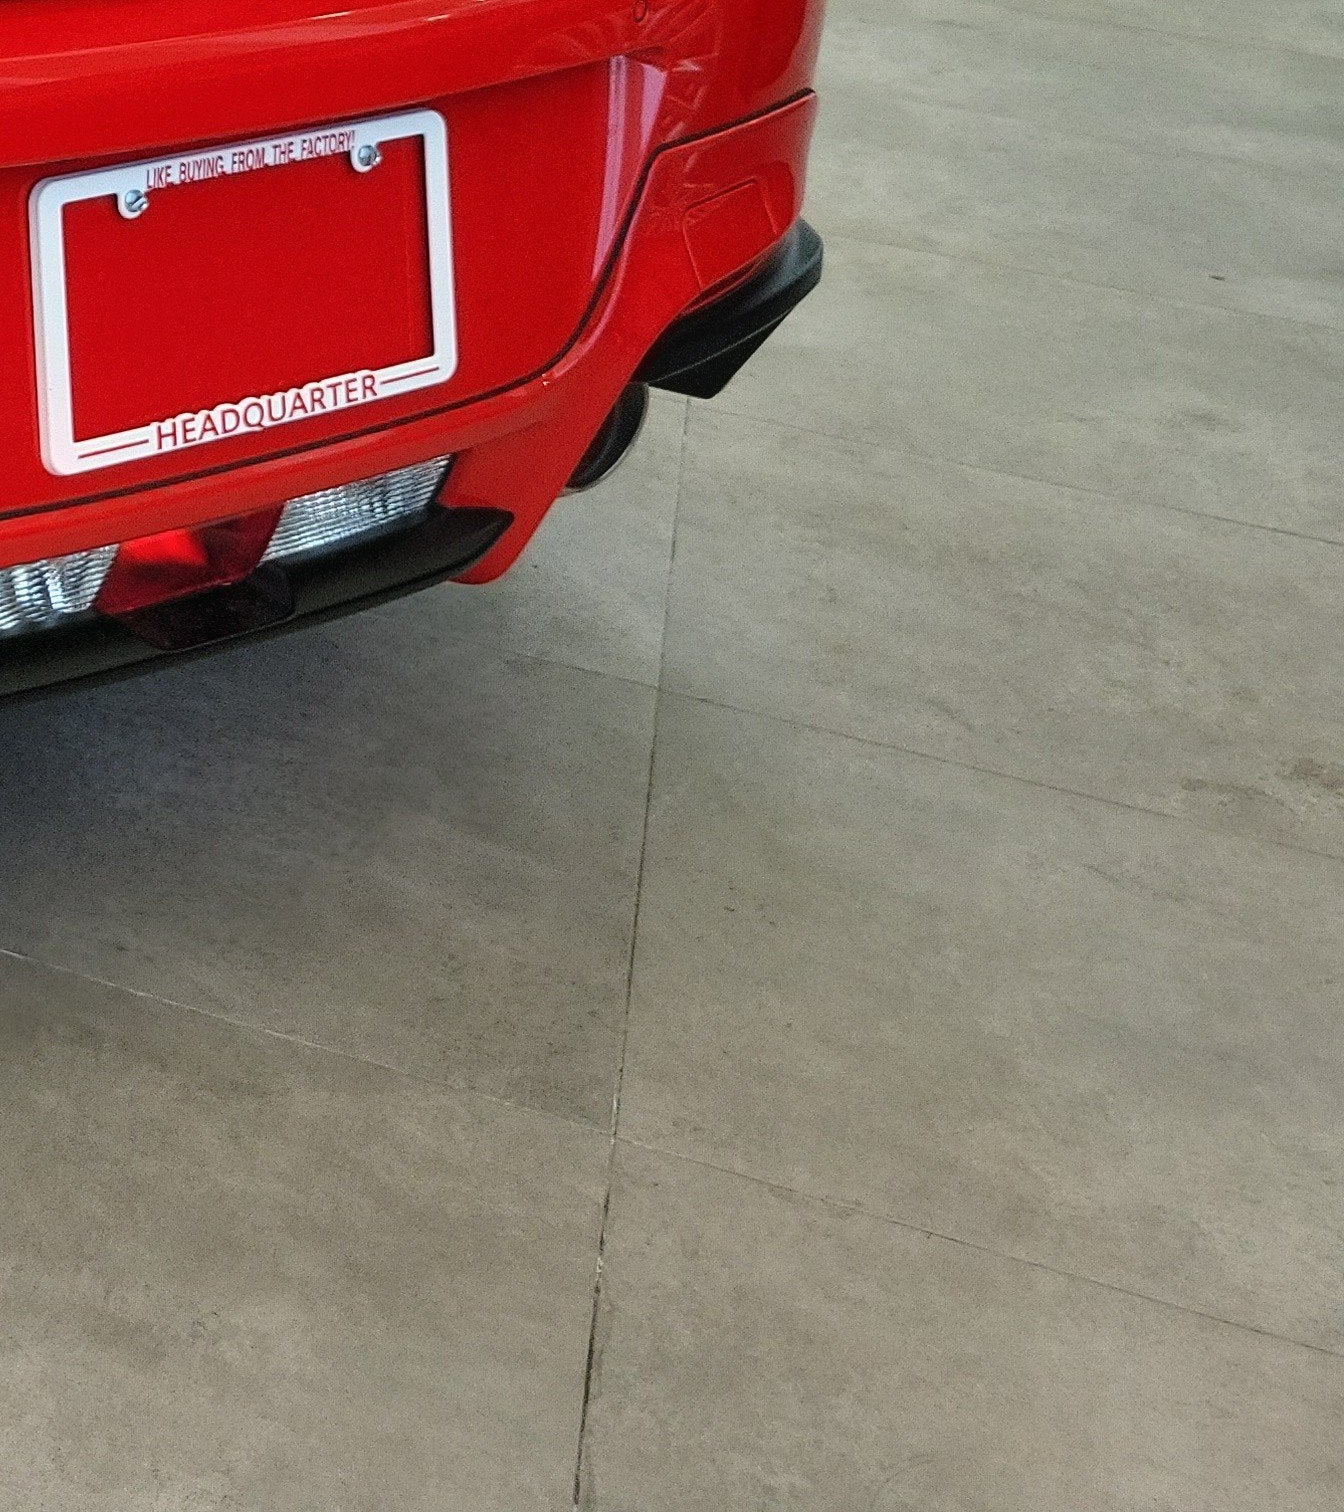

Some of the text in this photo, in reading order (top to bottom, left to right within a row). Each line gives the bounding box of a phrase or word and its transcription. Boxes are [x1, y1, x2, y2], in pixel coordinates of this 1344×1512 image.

[146, 130, 356, 189] LIKE BUYING FROM THE FACTORY!
[156, 374, 378, 450] HEADQUARTER
